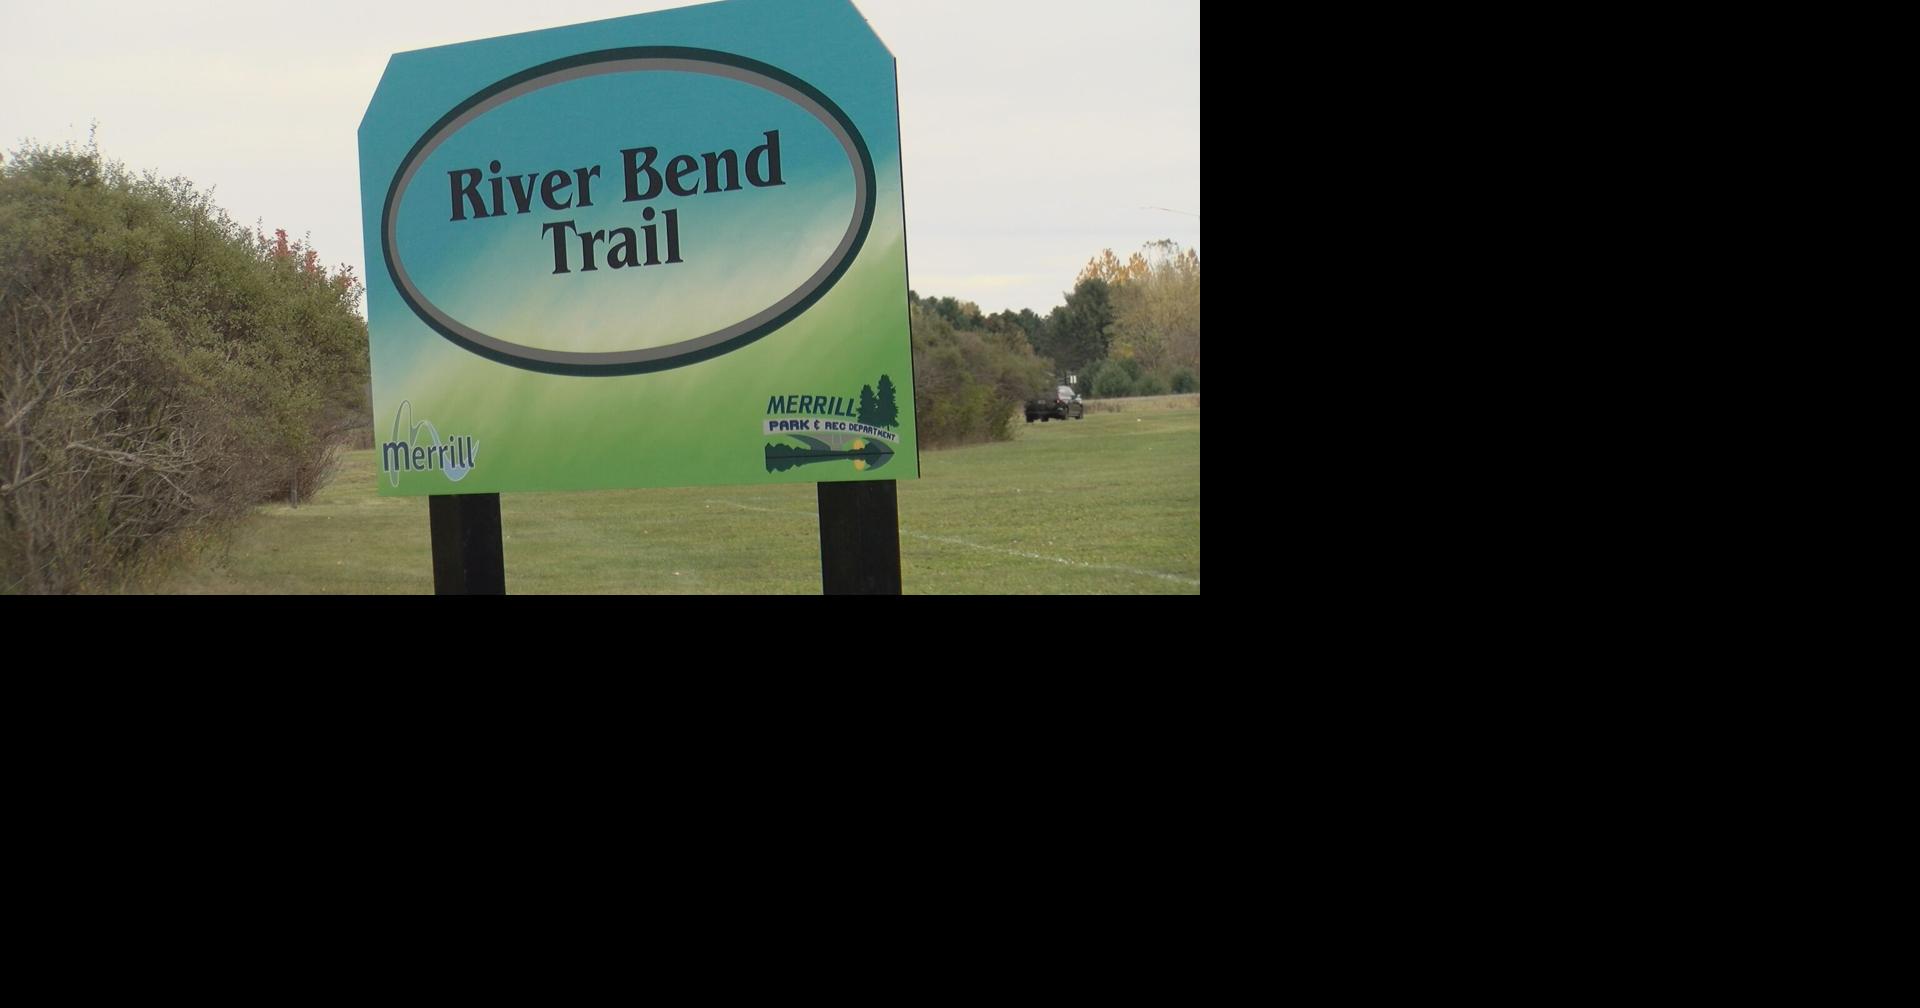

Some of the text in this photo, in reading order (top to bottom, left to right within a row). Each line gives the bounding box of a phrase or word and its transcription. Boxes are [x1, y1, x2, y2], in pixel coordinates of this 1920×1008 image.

[447, 129, 787, 222] River Bend
[541, 206, 685, 275] Trail
[766, 395, 857, 417] MERRILL
[769, 420, 810, 431] PARK
[824, 421, 846, 431] REC
[848, 423, 896, 441] DEPARTMENT
